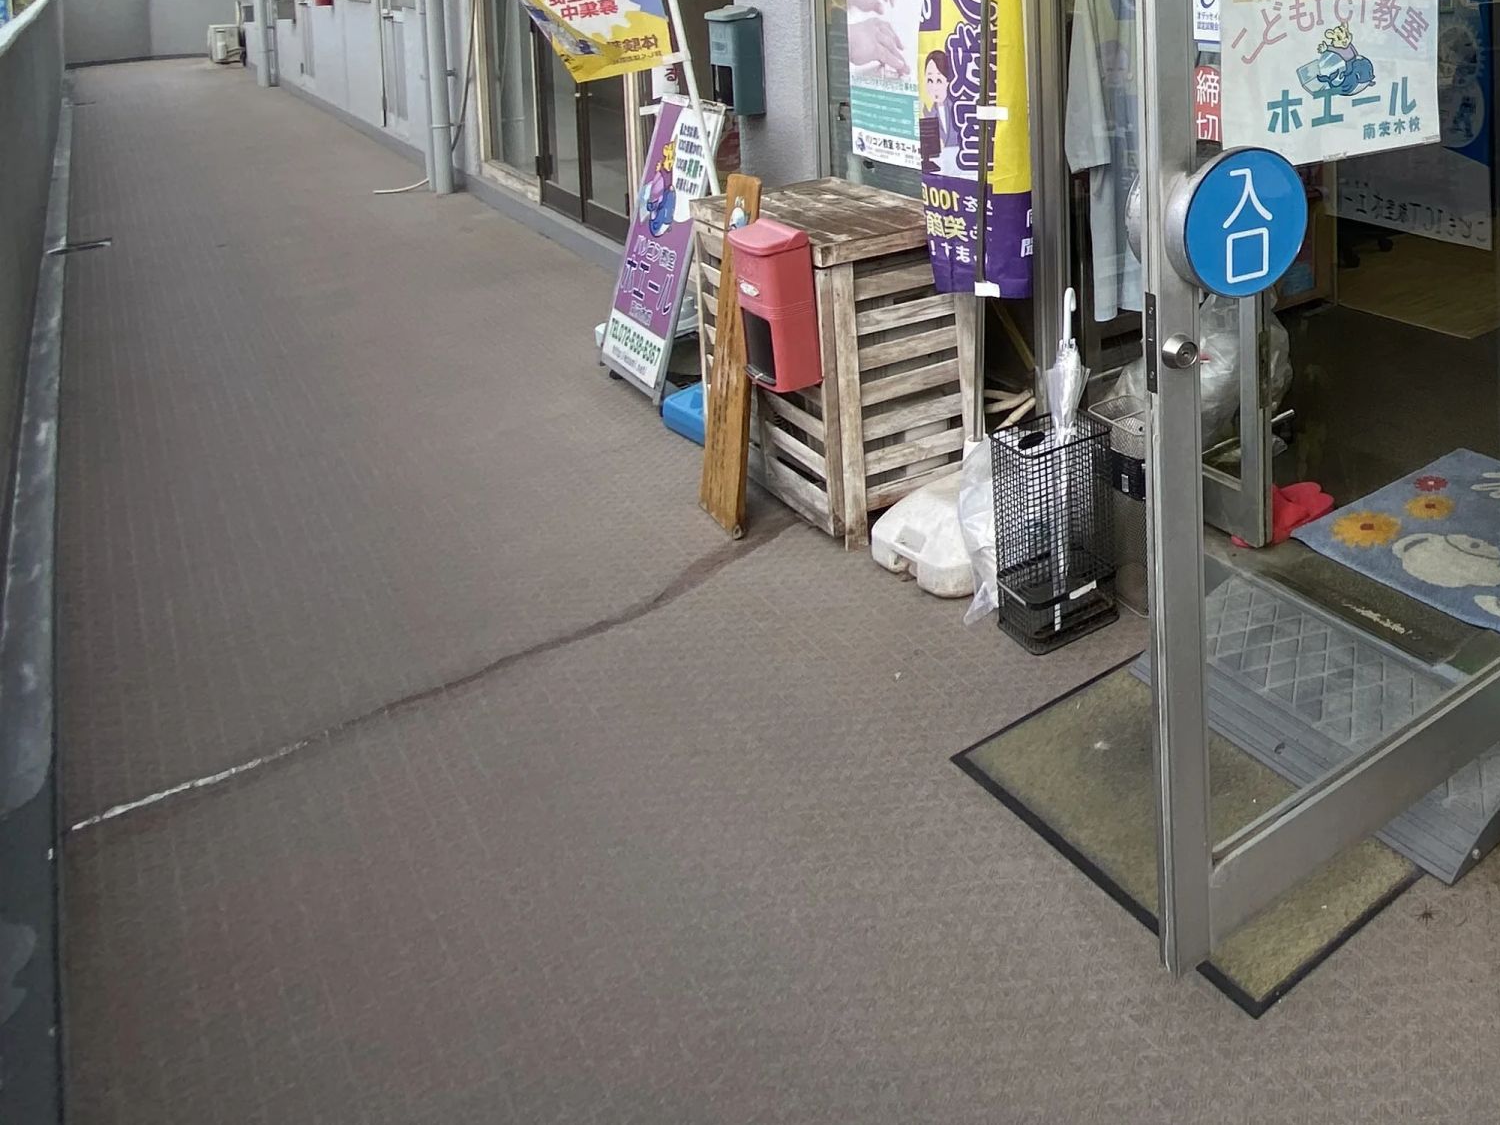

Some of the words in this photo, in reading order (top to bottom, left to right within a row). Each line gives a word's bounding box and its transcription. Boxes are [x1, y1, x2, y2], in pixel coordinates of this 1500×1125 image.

[1267, 77, 1416, 133] ホエール
[1363, 116, 1420, 140] 南茨木校
[1222, 168, 1273, 284] 入口
